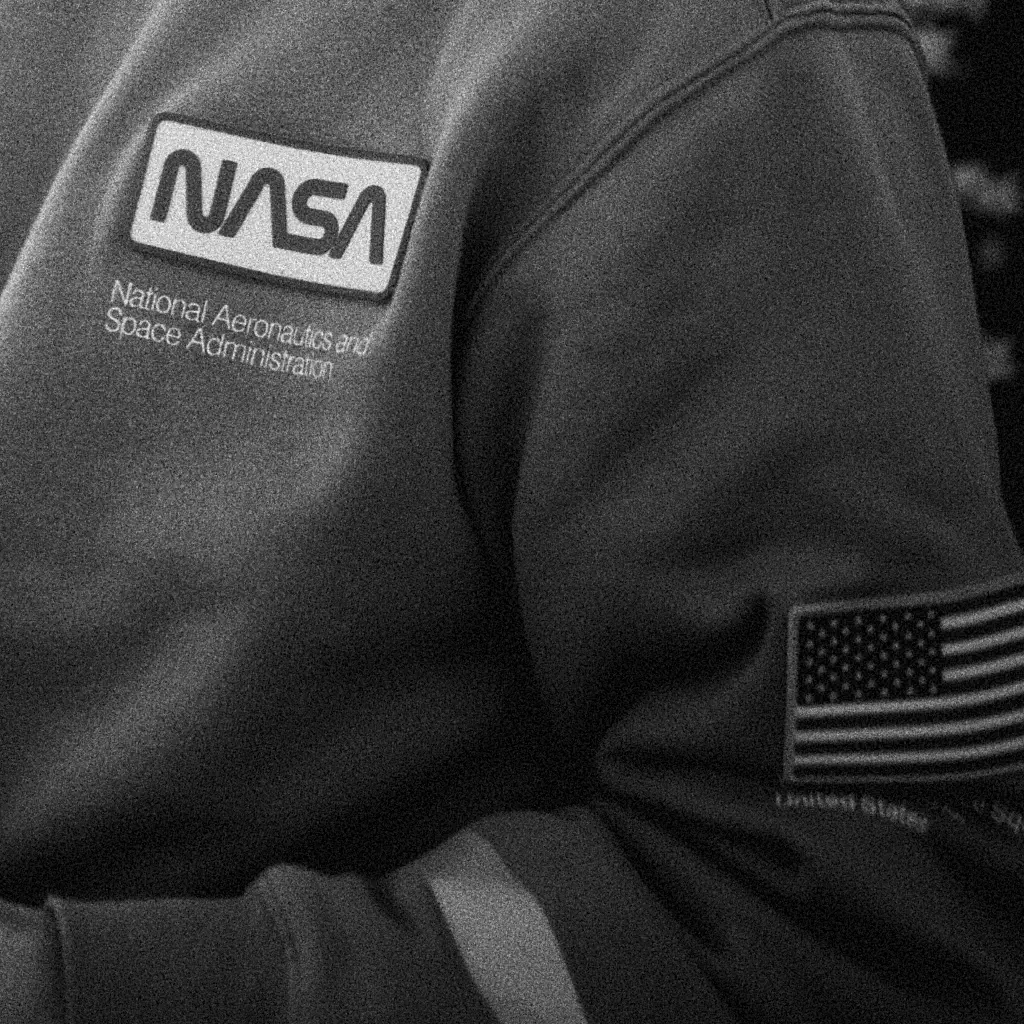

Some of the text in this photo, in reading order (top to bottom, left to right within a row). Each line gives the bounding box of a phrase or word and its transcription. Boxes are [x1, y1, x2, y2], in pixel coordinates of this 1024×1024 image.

[150, 149, 387, 266] NASA
[104, 307, 334, 378] Space Administration
[110, 280, 372, 356] National Aeronautics and
